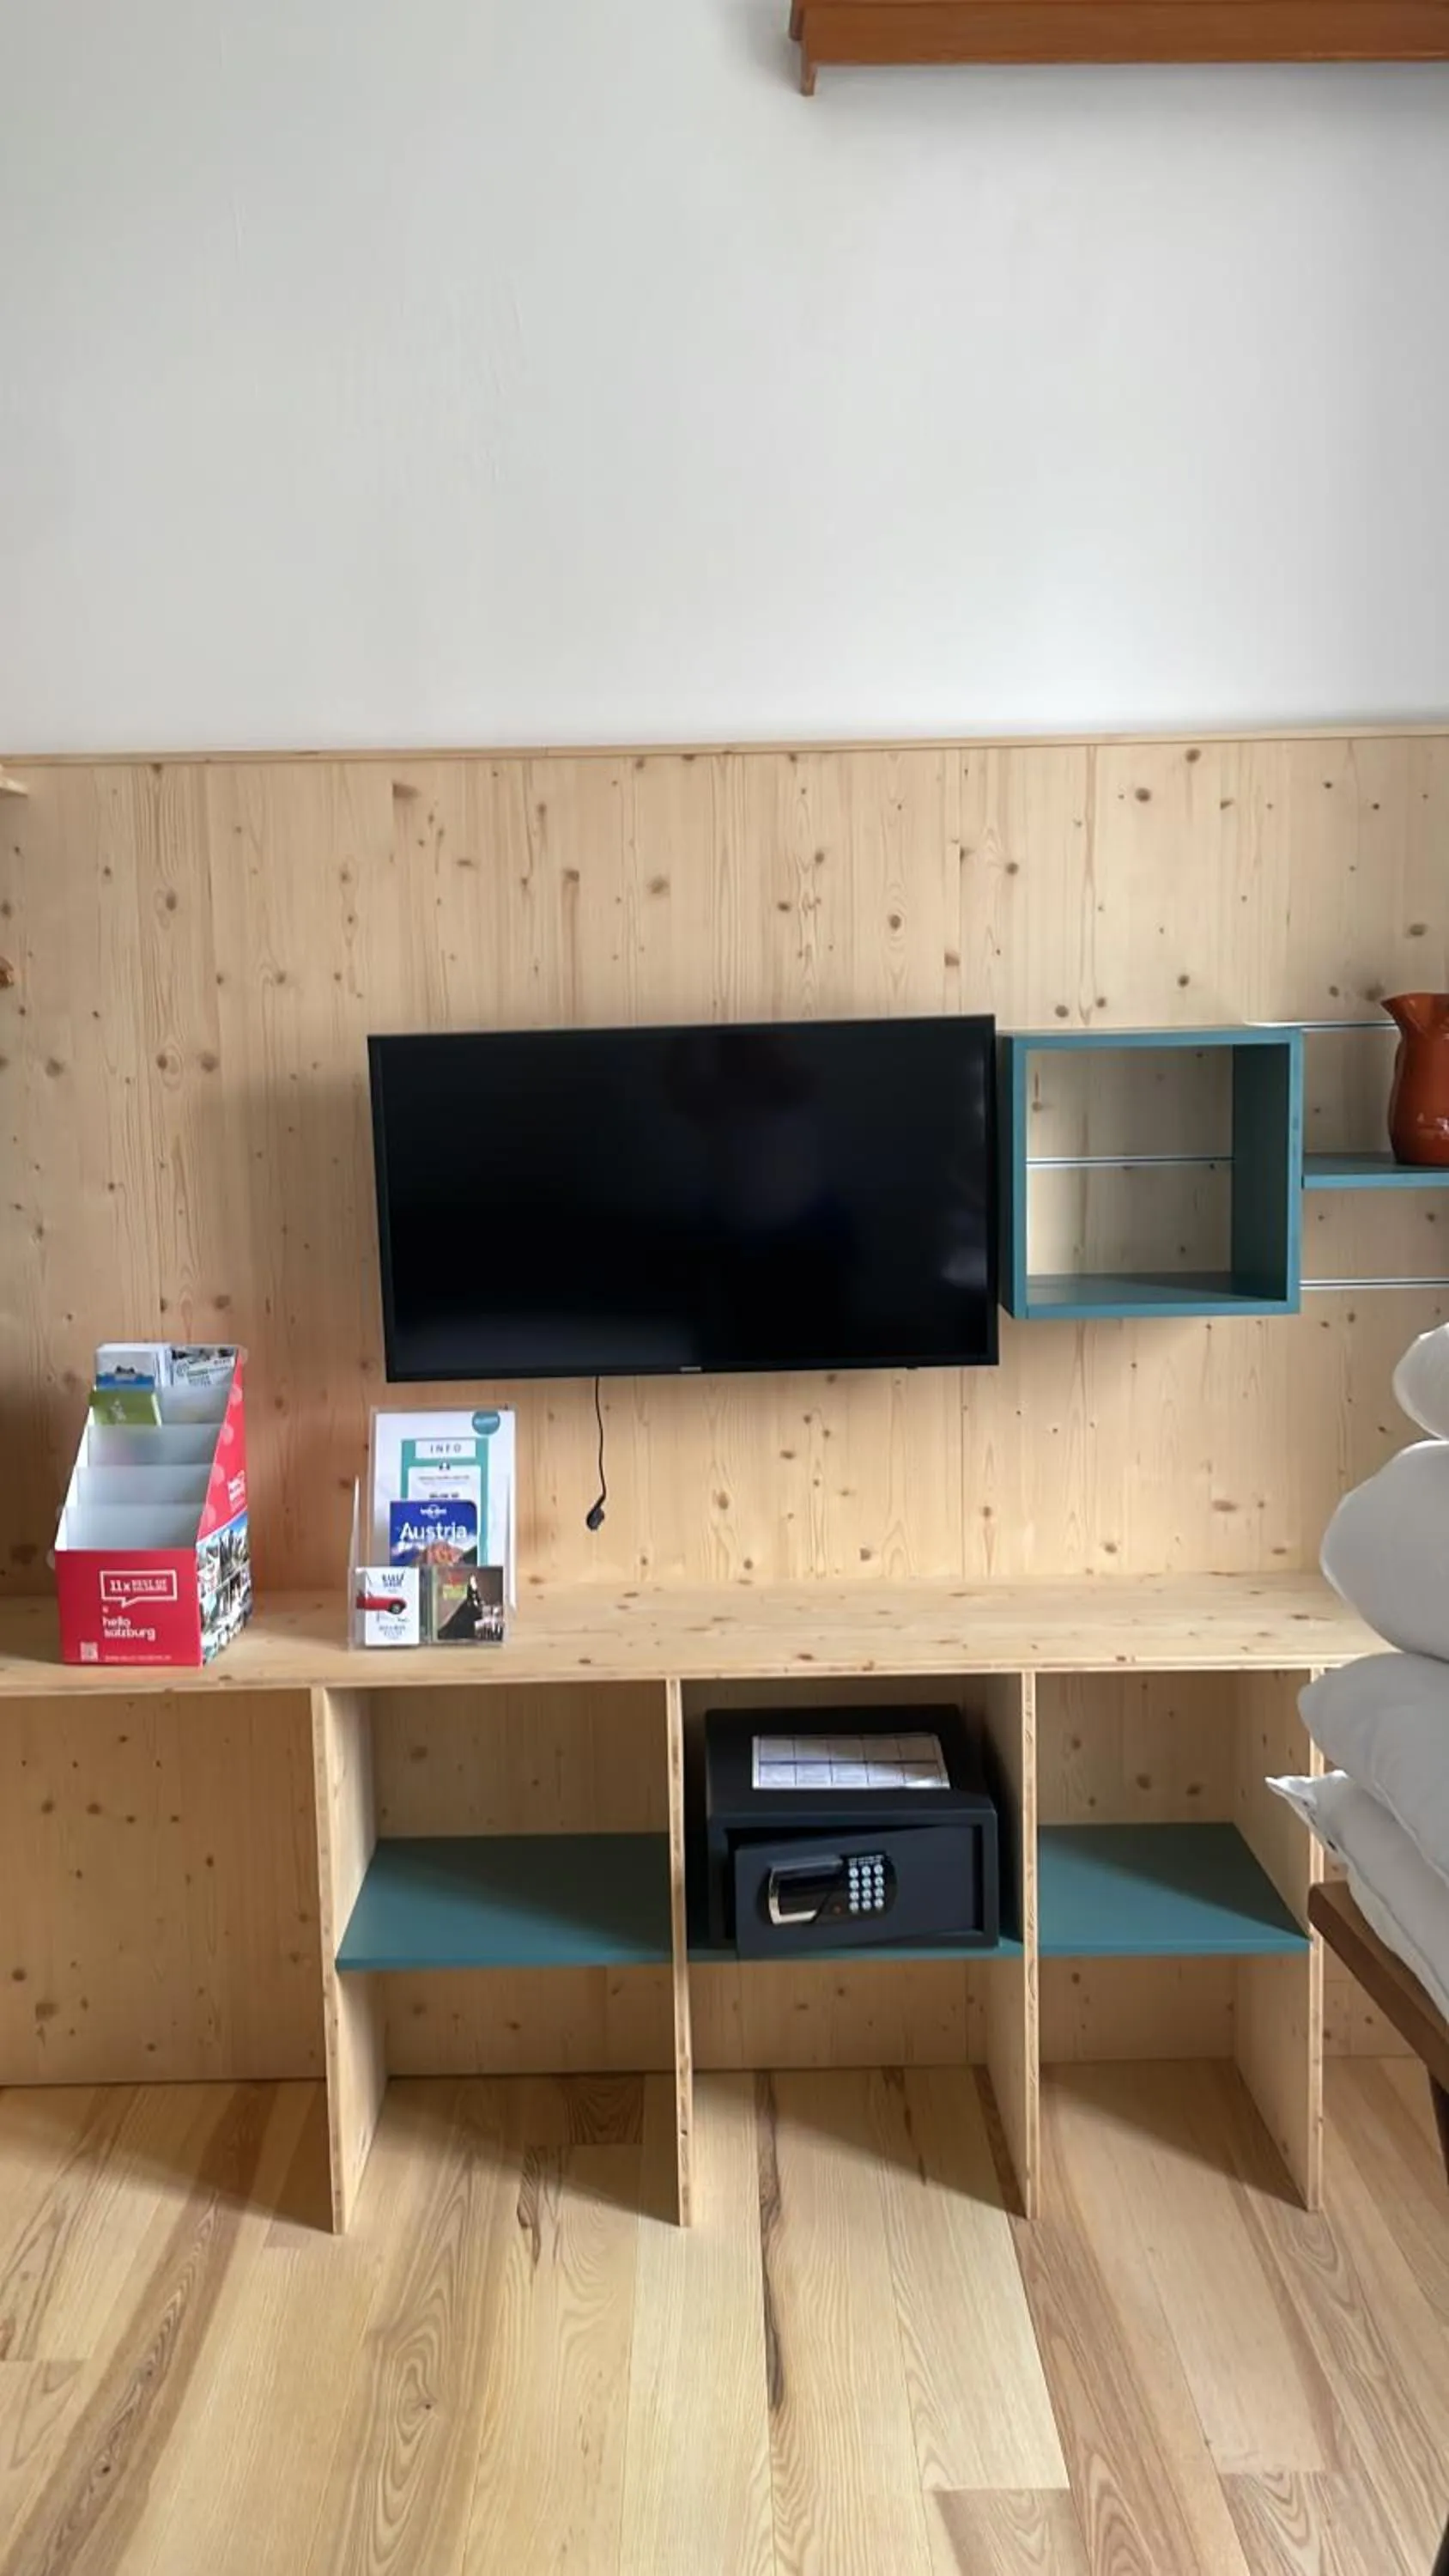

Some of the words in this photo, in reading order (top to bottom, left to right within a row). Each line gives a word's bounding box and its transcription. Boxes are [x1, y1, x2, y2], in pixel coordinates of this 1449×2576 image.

[430, 1443, 462, 1454] INFO
[400, 1521, 468, 1540] Austria
[102, 1615, 131, 1627] hello
[104, 1626, 156, 1642] salzburg
